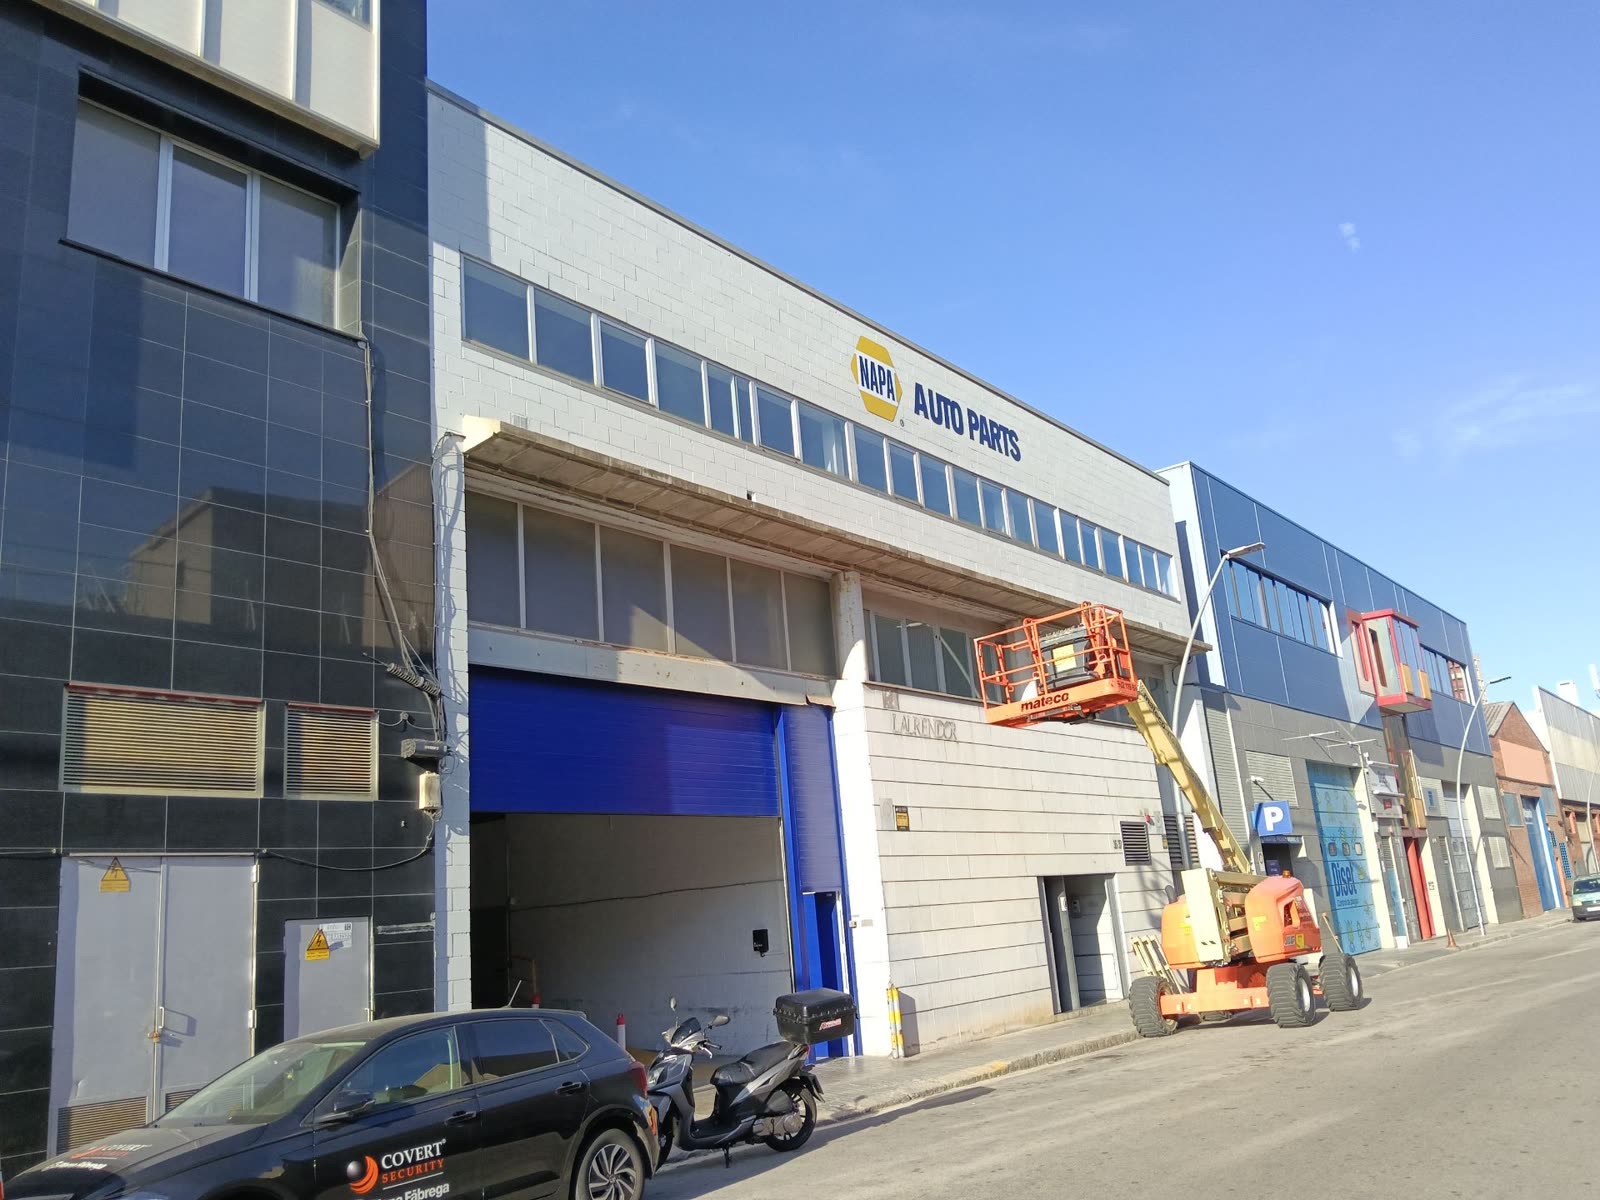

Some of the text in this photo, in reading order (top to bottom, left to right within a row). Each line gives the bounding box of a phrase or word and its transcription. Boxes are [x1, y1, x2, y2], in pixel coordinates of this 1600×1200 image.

[858, 355, 896, 402] NAPA
[914, 382, 1022, 462] AUTO PARTS
[1021, 692, 1069, 712] mateco
[1263, 806, 1284, 831] P
[381, 1141, 443, 1169] COVERT
[382, 1158, 444, 1183] SECURITY
